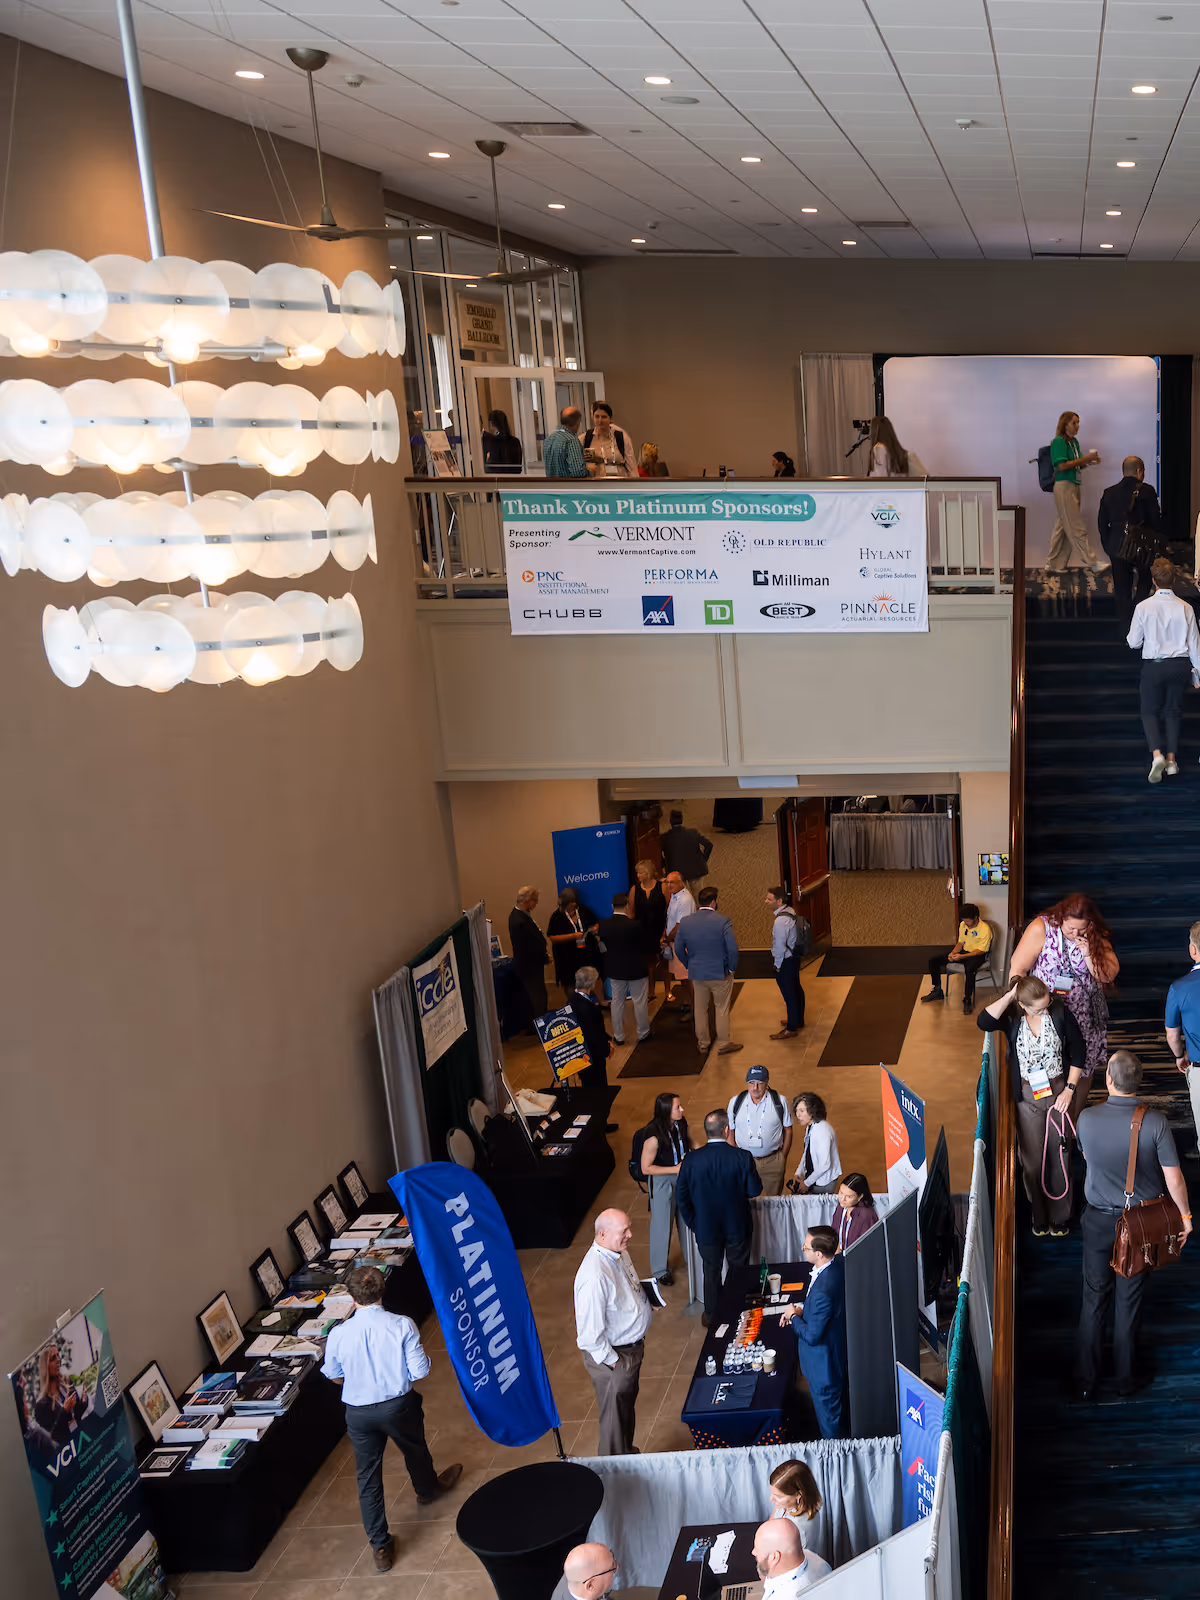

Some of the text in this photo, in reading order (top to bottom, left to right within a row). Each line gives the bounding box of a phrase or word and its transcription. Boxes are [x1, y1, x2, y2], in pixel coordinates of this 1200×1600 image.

[472, 317, 494, 331] GRAND
[503, 499, 809, 517] Thank You Platinum Sponsors!
[871, 512, 900, 521] VCIA
[508, 529, 560, 539] Presenting
[614, 526, 695, 541] VERMONT
[509, 540, 552, 549] Sponsor:
[754, 538, 828, 547] OLD REPUBLIC
[597, 548, 696, 556] www.VermontCaptive.com
[860, 548, 912, 560] HYLANT
[536, 571, 564, 581] PNC
[644, 569, 719, 580] PERFORMA
[772, 574, 830, 586] Milliman
[523, 609, 603, 619] CHUBB
[706, 605, 730, 621] TD
[772, 607, 803, 615] BEST
[841, 603, 916, 614] PINNACLE
[644, 610, 670, 624] AXA
[563, 871, 610, 884] Welcome
[550, 1021, 570, 1038] RAFFLE
[444, 1191, 520, 1395] PLATINUM
[449, 1287, 489, 1392] SPONSOR
[906, 1405, 923, 1427] AXA
[46, 1430, 92, 1478] VCIA
[59, 1491, 77, 1512] Smart
[77, 1466, 100, 1493] Captive
[99, 1437, 127, 1469] Advocacy
[89, 1492, 112, 1517] Captive
[111, 1463, 135, 1492] Educator
[98, 1515, 128, 1551] Connector
[72, 1544, 95, 1571] Captive
